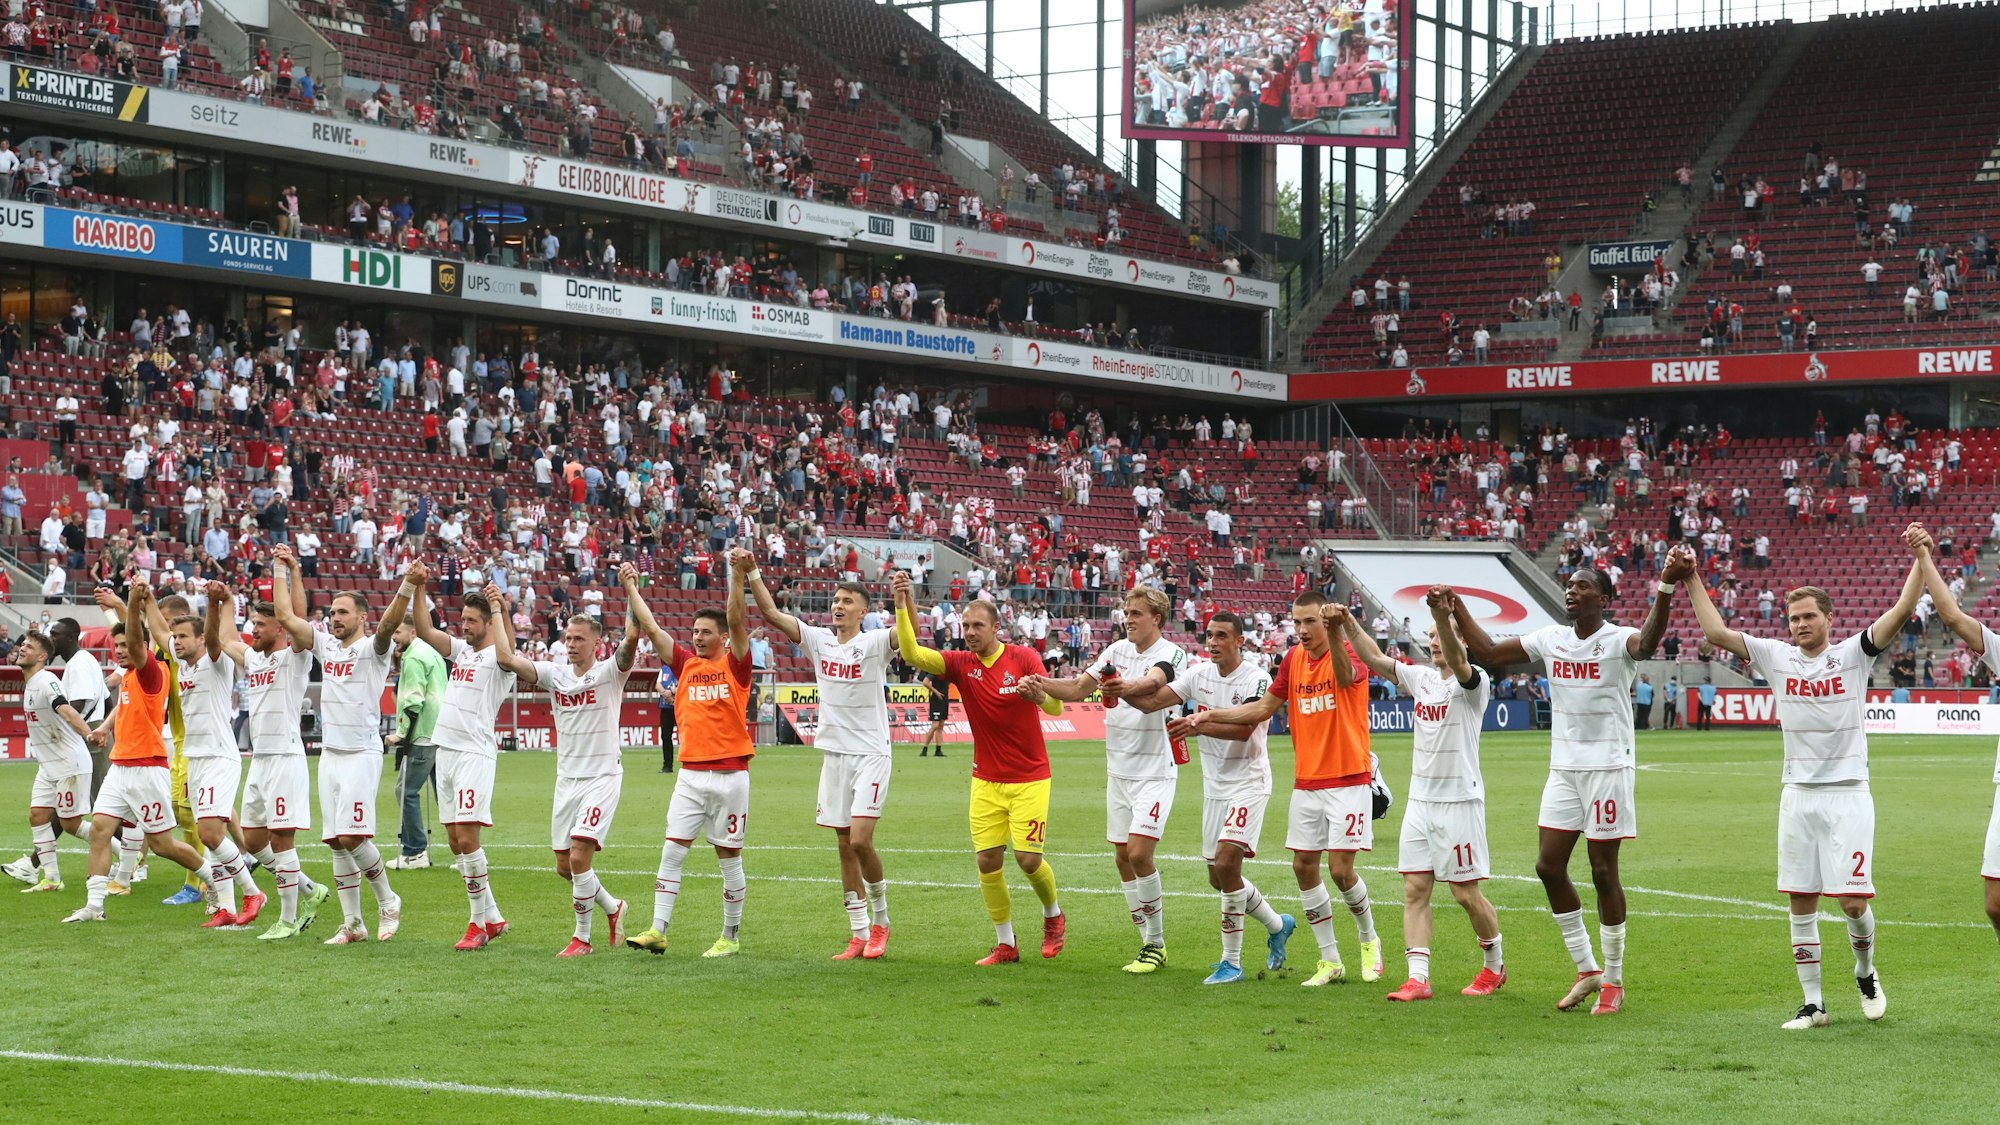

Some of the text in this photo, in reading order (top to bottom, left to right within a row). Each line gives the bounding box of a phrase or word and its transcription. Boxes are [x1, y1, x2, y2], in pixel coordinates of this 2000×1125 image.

[17, 67, 114, 103] X-PRINT.DE
[16, 91, 67, 107] TEXTILDRUCK
[76, 101, 114, 114] STICKEREI
[191, 104, 240, 127] seitz
[312, 122, 352, 146] REWE
[1227, 134, 1305, 144] TELEKOM STADION-TV
[429, 142, 467, 165] REWE
[716, 190, 762, 208] DEUTSCHE
[716, 203, 762, 220] STEINZEUG
[74, 216, 154, 252] HARIBO
[870, 218, 893, 236] UTH
[912, 225, 934, 242] UTH
[208, 232, 288, 262] SAUREN
[1590, 247, 1630, 265] Gaffel
[265, 264, 273, 272] AG
[1036, 250, 1075, 267] RheinEnergie
[1090, 254, 1109, 267] Rhein
[343, 248, 401, 289] HDI
[1087, 262, 1113, 278] Energie
[1140, 269, 1175, 284] RheinEnergie
[1189, 271, 1207, 283] Rhein
[566, 279, 622, 303] Dorint
[1187, 279, 1211, 294] Energie
[1236, 284, 1268, 299] RheinEnergie
[565, 300, 586, 312] Hotels
[595, 304, 622, 317] Resorts
[671, 296, 737, 323] funny-frisch
[768, 308, 810, 326] OSMAB
[841, 321, 902, 345] Hamann
[906, 330, 975, 355] Baustoffe
[1042, 351, 1080, 367] RheinEnergie
[1918, 350, 1993, 373] REWE
[1506, 366, 1572, 389] REWE
[1651, 360, 1720, 383] REWE
[1244, 378, 1276, 392] RheinEnergie
[687, 672, 727, 684] uhlsport
[821, 660, 862, 679] REWE
[1553, 660, 1600, 680] REWE
[248, 671, 276, 688] EWE
[1785, 676, 1846, 698] REWE
[554, 690, 597, 707] REWE
[688, 684, 730, 701] REWE
[892, 690, 925, 703] Radio
[999, 686, 1018, 695] REW
[1368, 704, 1404, 729] sbach
[1937, 709, 1980, 721] plana
[517, 728, 550, 748] EWE
[620, 727, 653, 746] EWE
[57, 791, 74, 807] 29
[198, 787, 214, 806] 21
[458, 789, 475, 809] 13
[871, 783, 880, 804] 7
[141, 803, 164, 822] 22
[275, 797, 286, 816] 6
[353, 802, 364, 823] 5
[1149, 802, 1160, 823] 4
[1594, 800, 1616, 824] 19
[582, 807, 601, 827] 18
[727, 813, 747, 834] 31
[1224, 807, 1247, 828] 28
[1345, 813, 1364, 836] 25
[1026, 820, 1045, 842] 20
[1453, 843, 1472, 867] 11
[1852, 851, 1865, 877] 2
